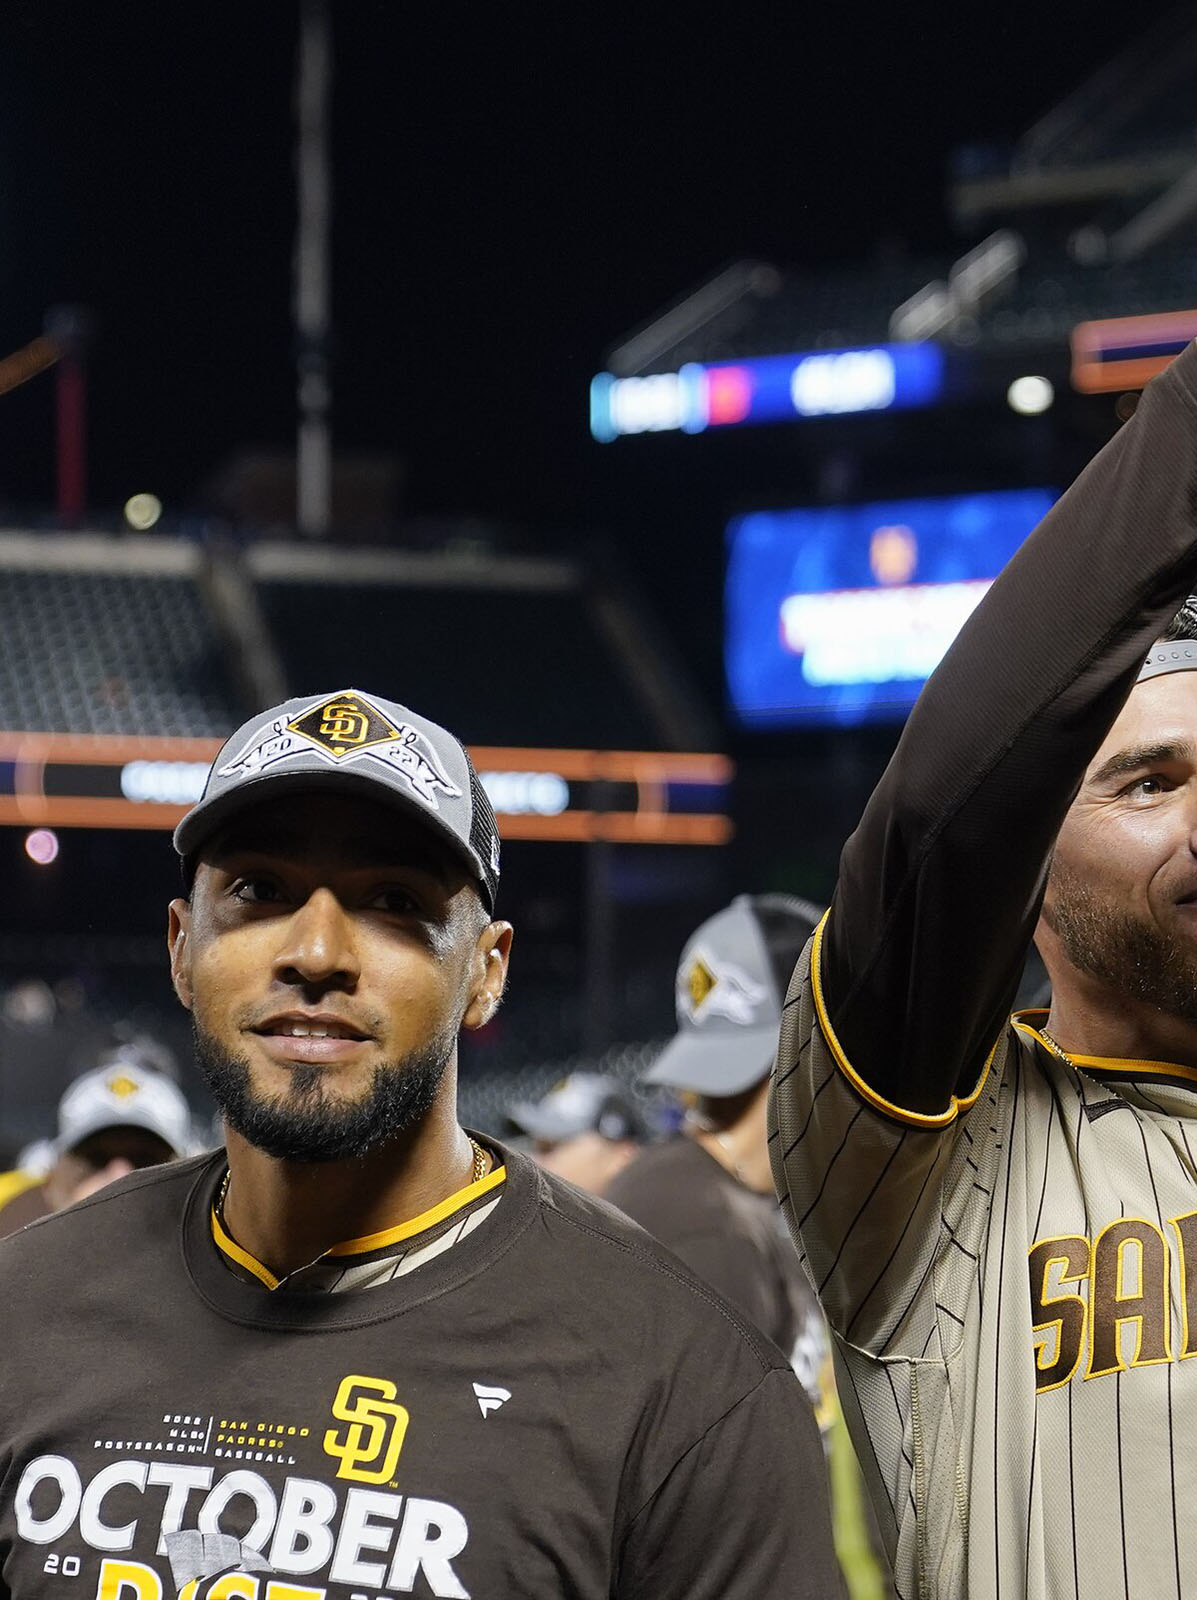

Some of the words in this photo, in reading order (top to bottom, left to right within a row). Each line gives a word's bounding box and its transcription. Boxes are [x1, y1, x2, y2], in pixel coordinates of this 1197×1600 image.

[320, 704, 369, 743] SD
[219, 1420, 248, 1431] SAN
[257, 1423, 310, 1437] DIEGO
[323, 1375, 410, 1485] SD
[214, 1448, 297, 1465] BASEBALL
[14, 1454, 470, 1598] OCTOBER
[43, 1553, 82, 1578] 20
